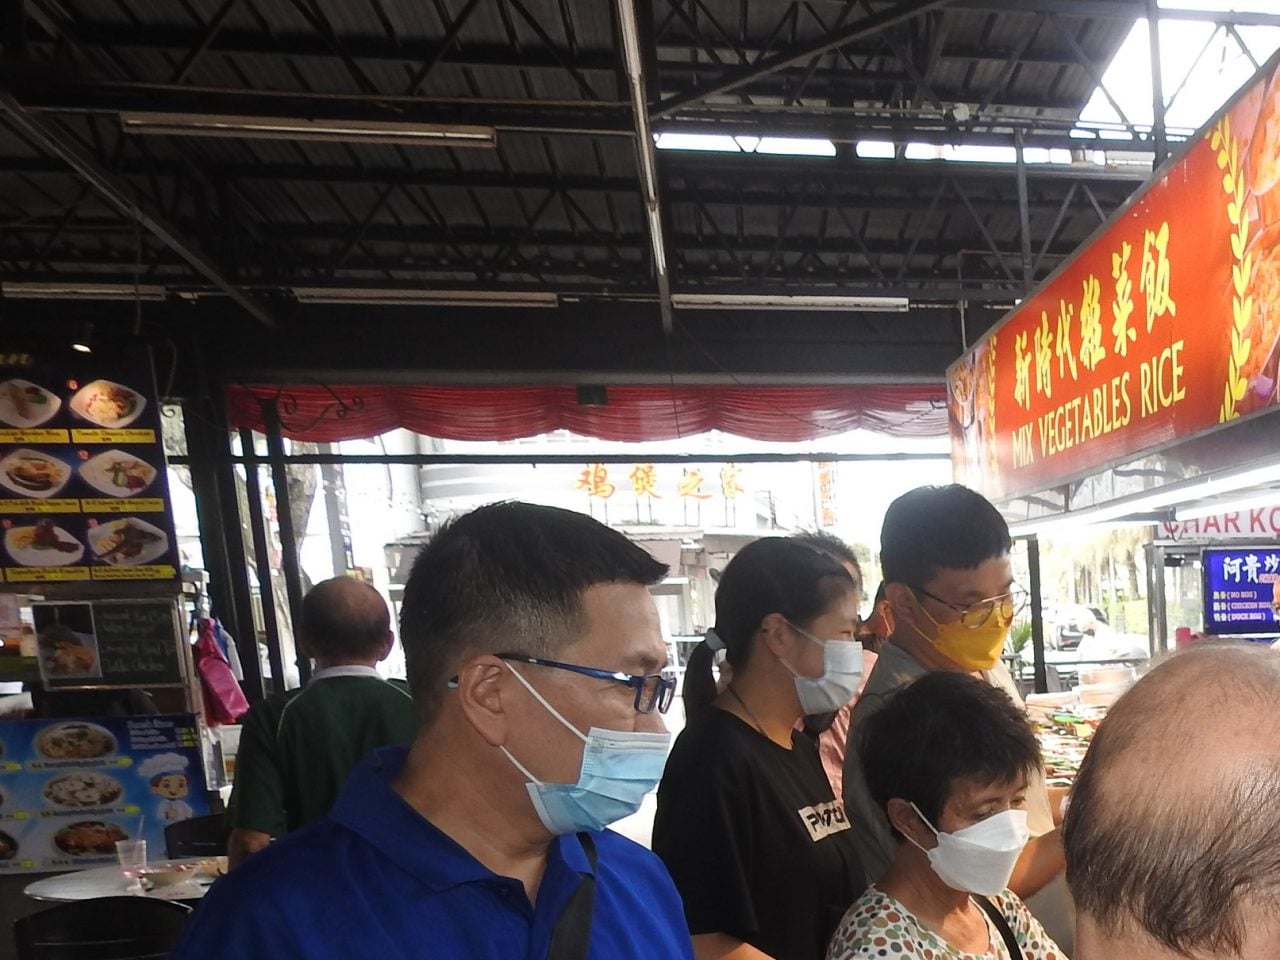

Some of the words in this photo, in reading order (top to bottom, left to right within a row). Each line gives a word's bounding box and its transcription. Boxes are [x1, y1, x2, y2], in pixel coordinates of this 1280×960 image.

[1012, 422, 1034, 469] MIX
[1038, 371, 1131, 457] VEGETABLES
[1140, 340, 1186, 418] RICE
